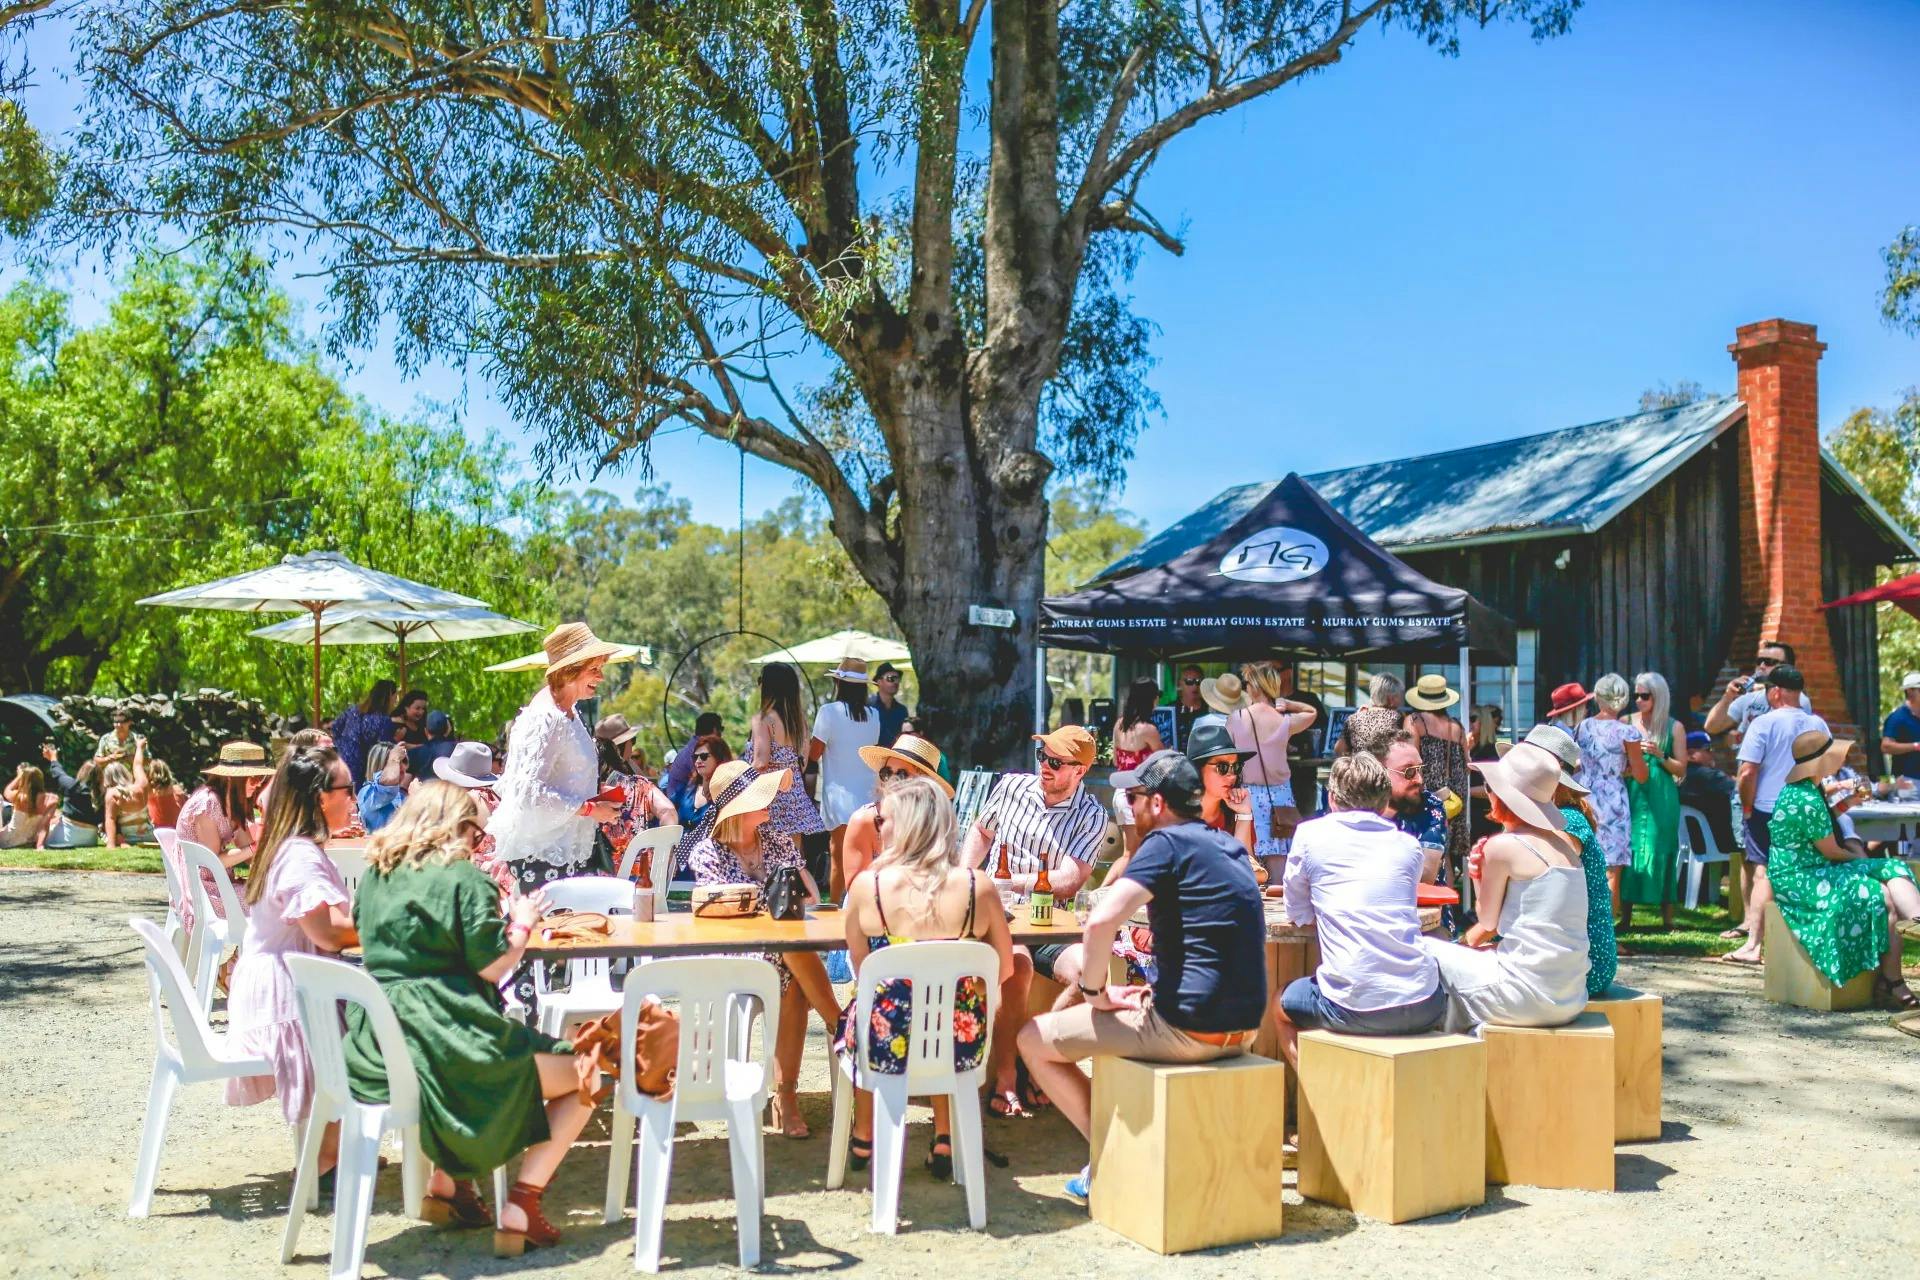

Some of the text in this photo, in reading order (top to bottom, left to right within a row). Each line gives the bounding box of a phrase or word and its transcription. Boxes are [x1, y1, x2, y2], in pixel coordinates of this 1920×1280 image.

[1052, 616, 1451, 628] MURRAY GUMS ESTATE MURRAY GUMS ESTATE MURRAY GUMS ESTATE
